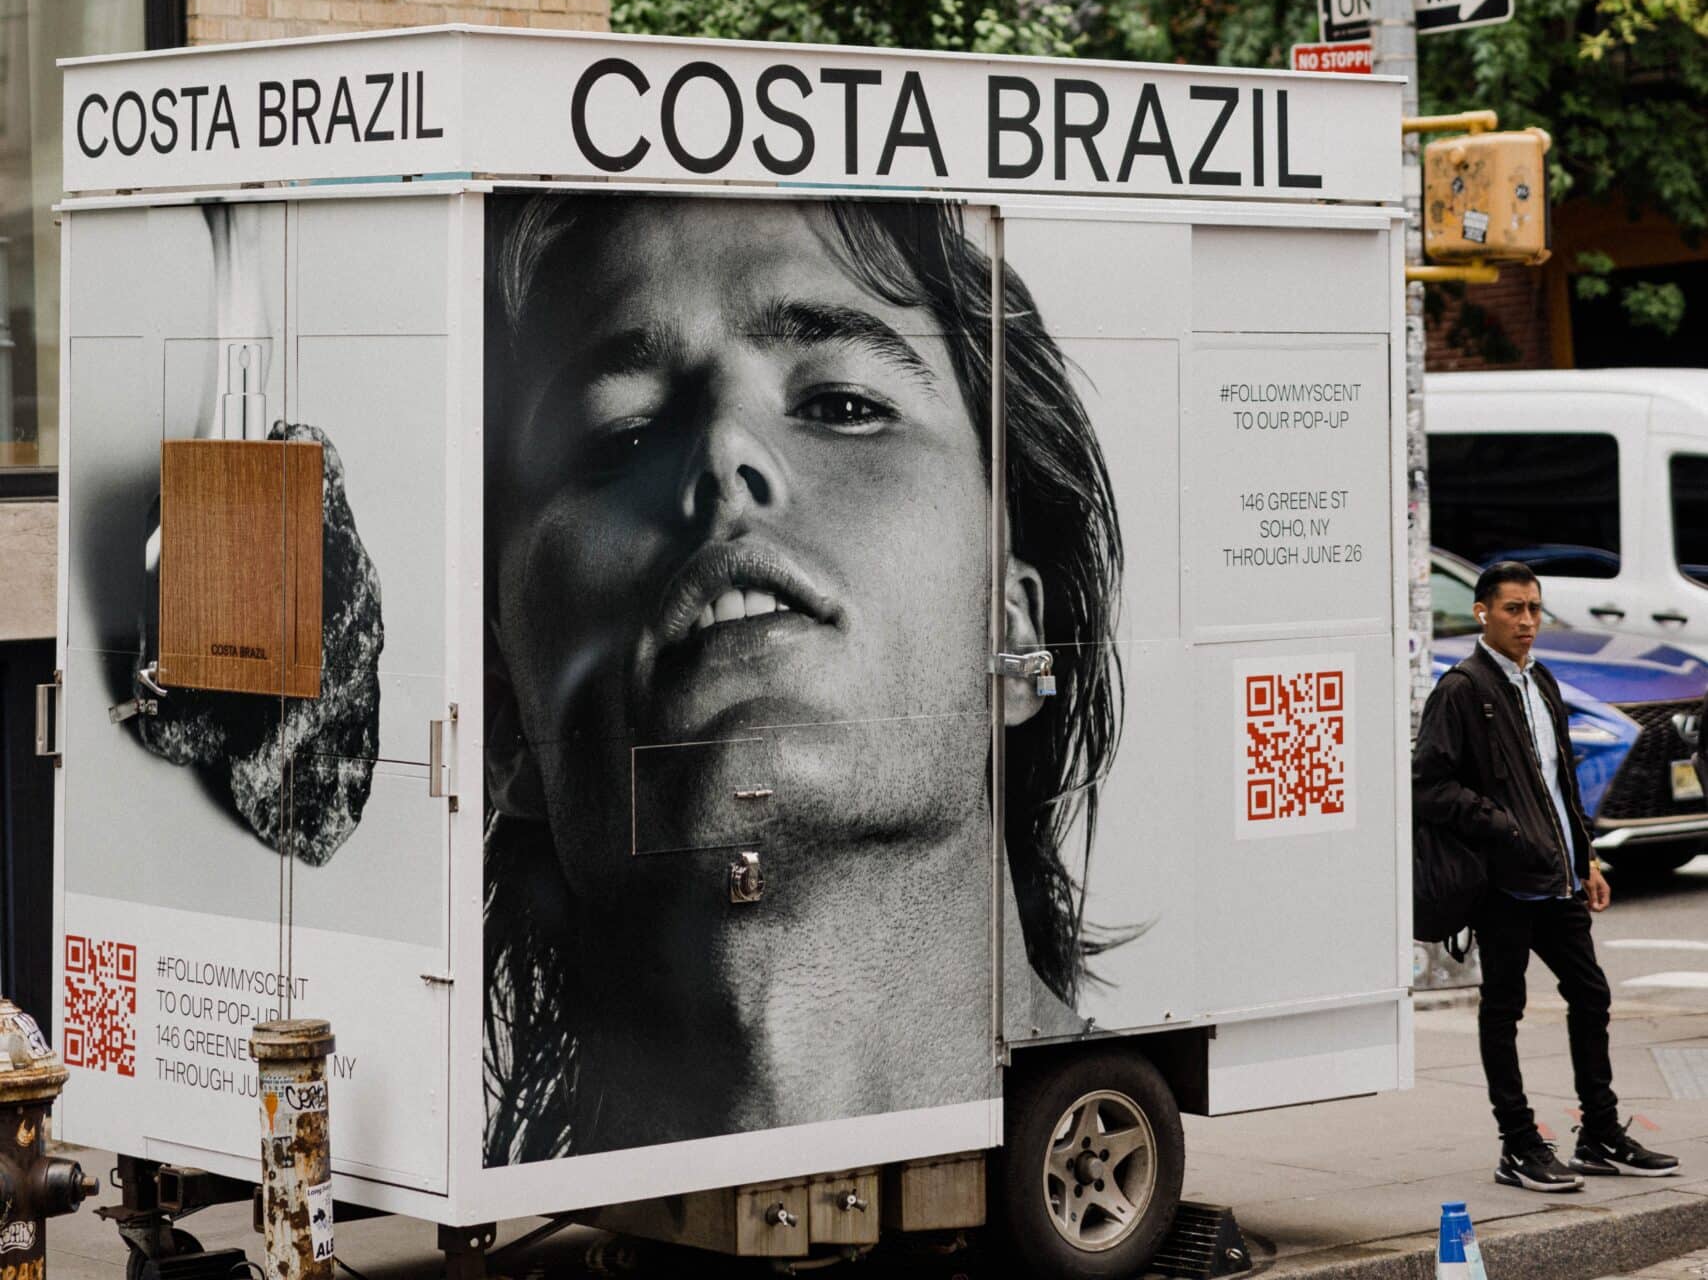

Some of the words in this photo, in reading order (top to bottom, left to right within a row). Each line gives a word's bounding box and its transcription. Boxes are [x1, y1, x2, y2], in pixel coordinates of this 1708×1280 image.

[1299, 53, 1319, 70] NO
[77, 84, 239, 159] COSTA
[258, 70, 444, 148] BRAZIL
[571, 57, 949, 176] COSTA
[987, 74, 1323, 189] BRAZIL
[1219, 384, 1361, 402] #FOLLOWMYSCENT
[1233, 411, 1253, 430] TO
[1257, 411, 1289, 430] OUR
[1293, 411, 1349, 429] POP-UP
[1240, 493, 1264, 511] 146
[1267, 491, 1327, 511] GREENE
[1331, 490, 1348, 509] ST
[1259, 519, 1306, 539] SOHO,
[1310, 519, 1330, 536] NY
[1223, 547, 1299, 566] THROUGH
[1303, 545, 1341, 564] JUNE
[1344, 544, 1362, 563] 26
[211, 644, 238, 657] COSTA
[239, 646, 268, 660] BRAZIL
[157, 955, 309, 1001] #FOLLOWMYSCENT
[156, 989, 177, 1014] TO
[179, 993, 213, 1020] OUR
[217, 999, 281, 1025] POP-UP
[156, 1024, 181, 1049] 146
[183, 1028, 247, 1061] GREENE
[333, 1055, 357, 1081] NY
[156, 1057, 234, 1094] THROUGH
[237, 1073, 259, 1098] JU
